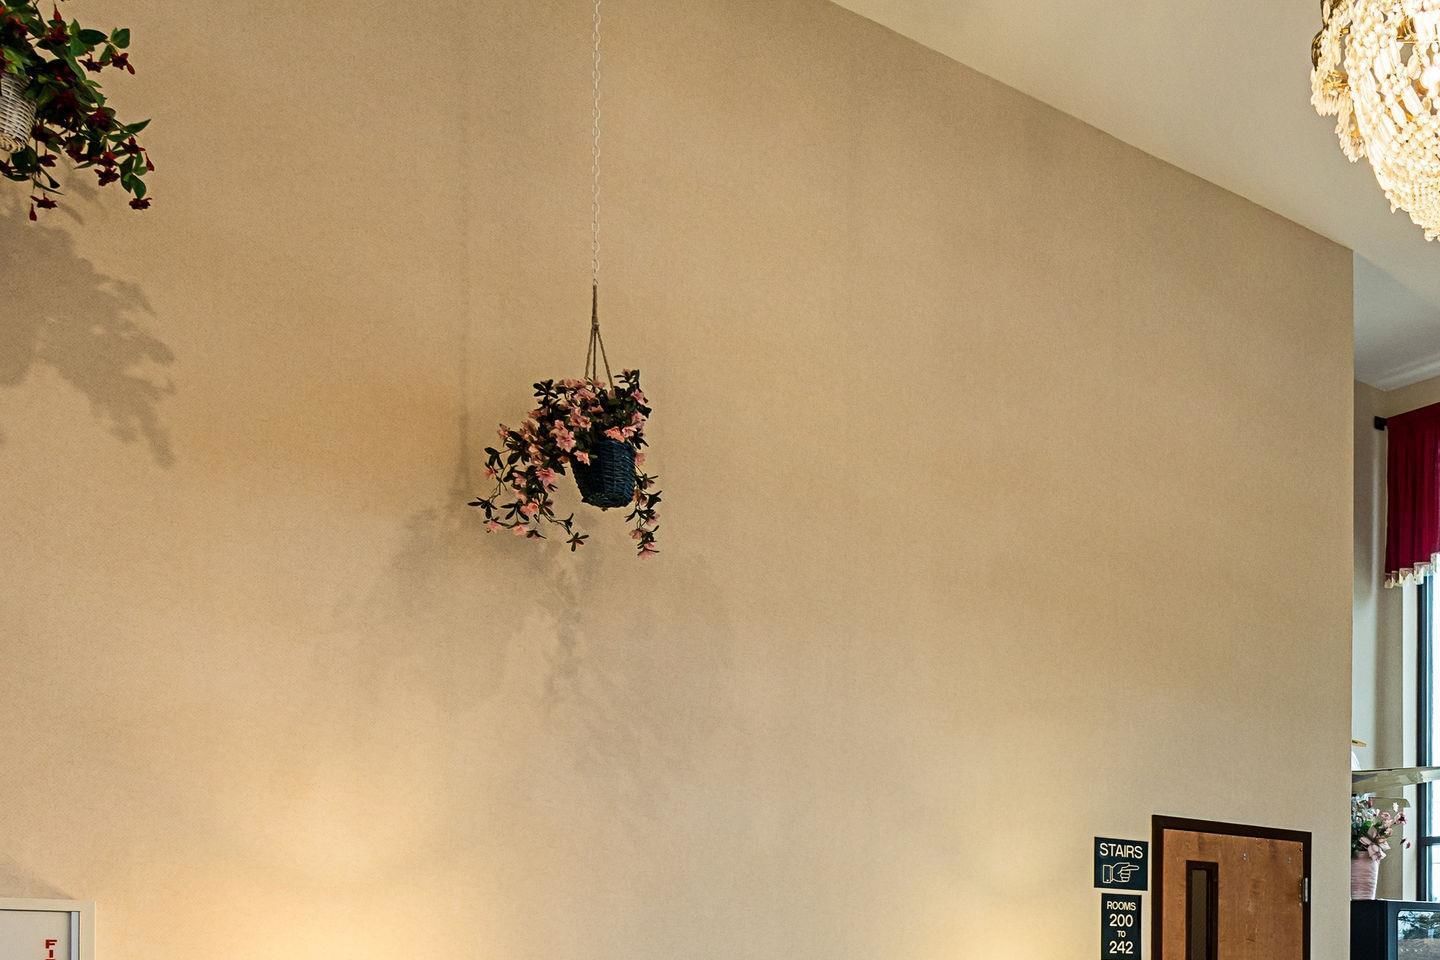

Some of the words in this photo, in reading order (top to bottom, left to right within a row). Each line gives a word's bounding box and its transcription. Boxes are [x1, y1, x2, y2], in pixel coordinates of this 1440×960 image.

[1099, 842, 1144, 860] STAIRS
[1106, 900, 1137, 911] ROOMS
[1108, 914, 1134, 928] 200
[1116, 930, 1127, 938] TO
[1108, 940, 1134, 955] 242
